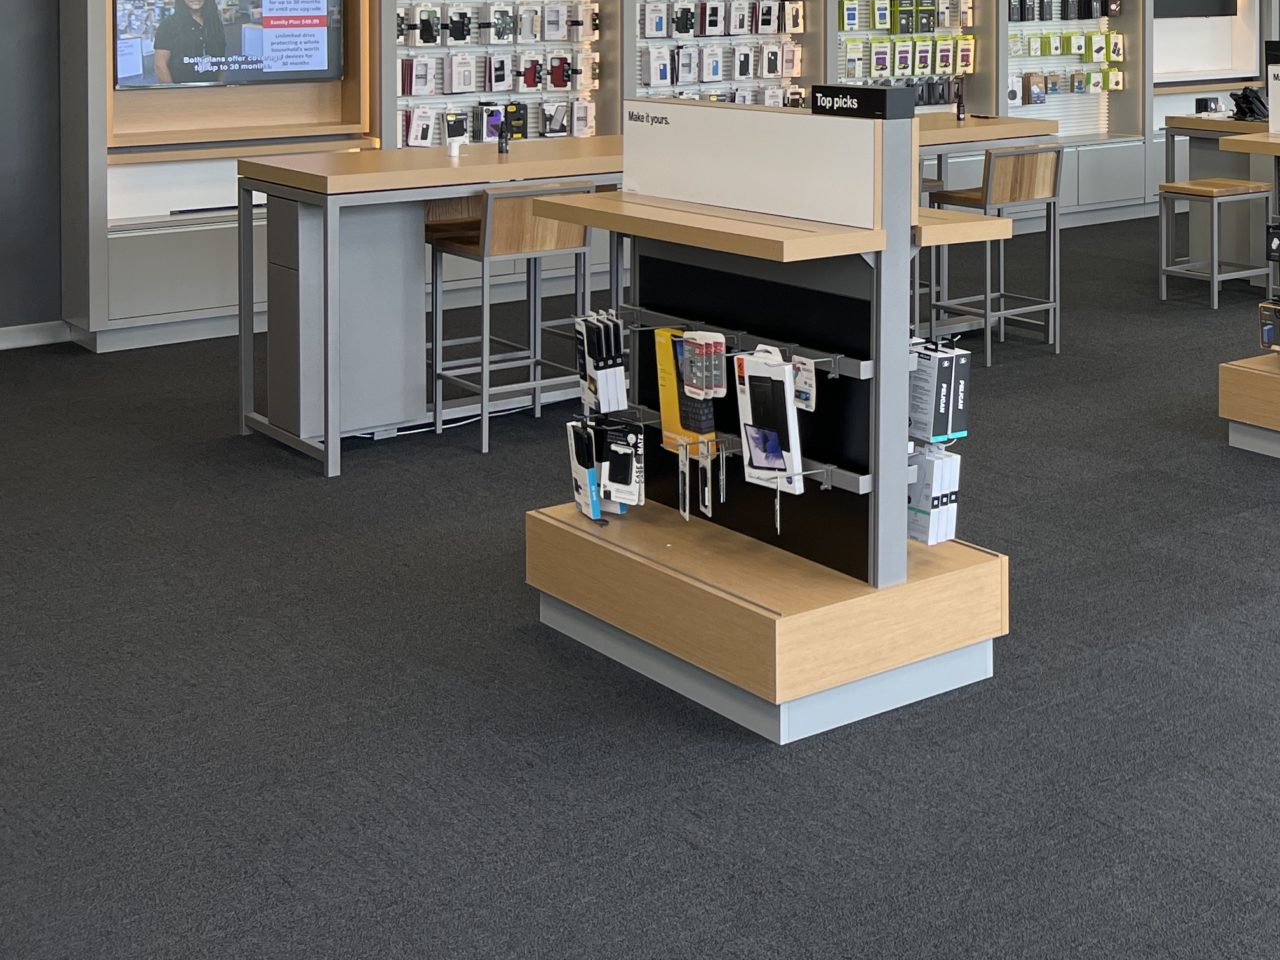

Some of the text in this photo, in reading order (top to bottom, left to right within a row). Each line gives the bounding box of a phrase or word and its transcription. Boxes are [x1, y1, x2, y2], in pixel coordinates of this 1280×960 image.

[815, 93, 859, 110] Top picks
[628, 110, 671, 126] Make it yours.
[939, 382, 948, 414] PELICAN
[957, 379, 966, 410] PELICAN
